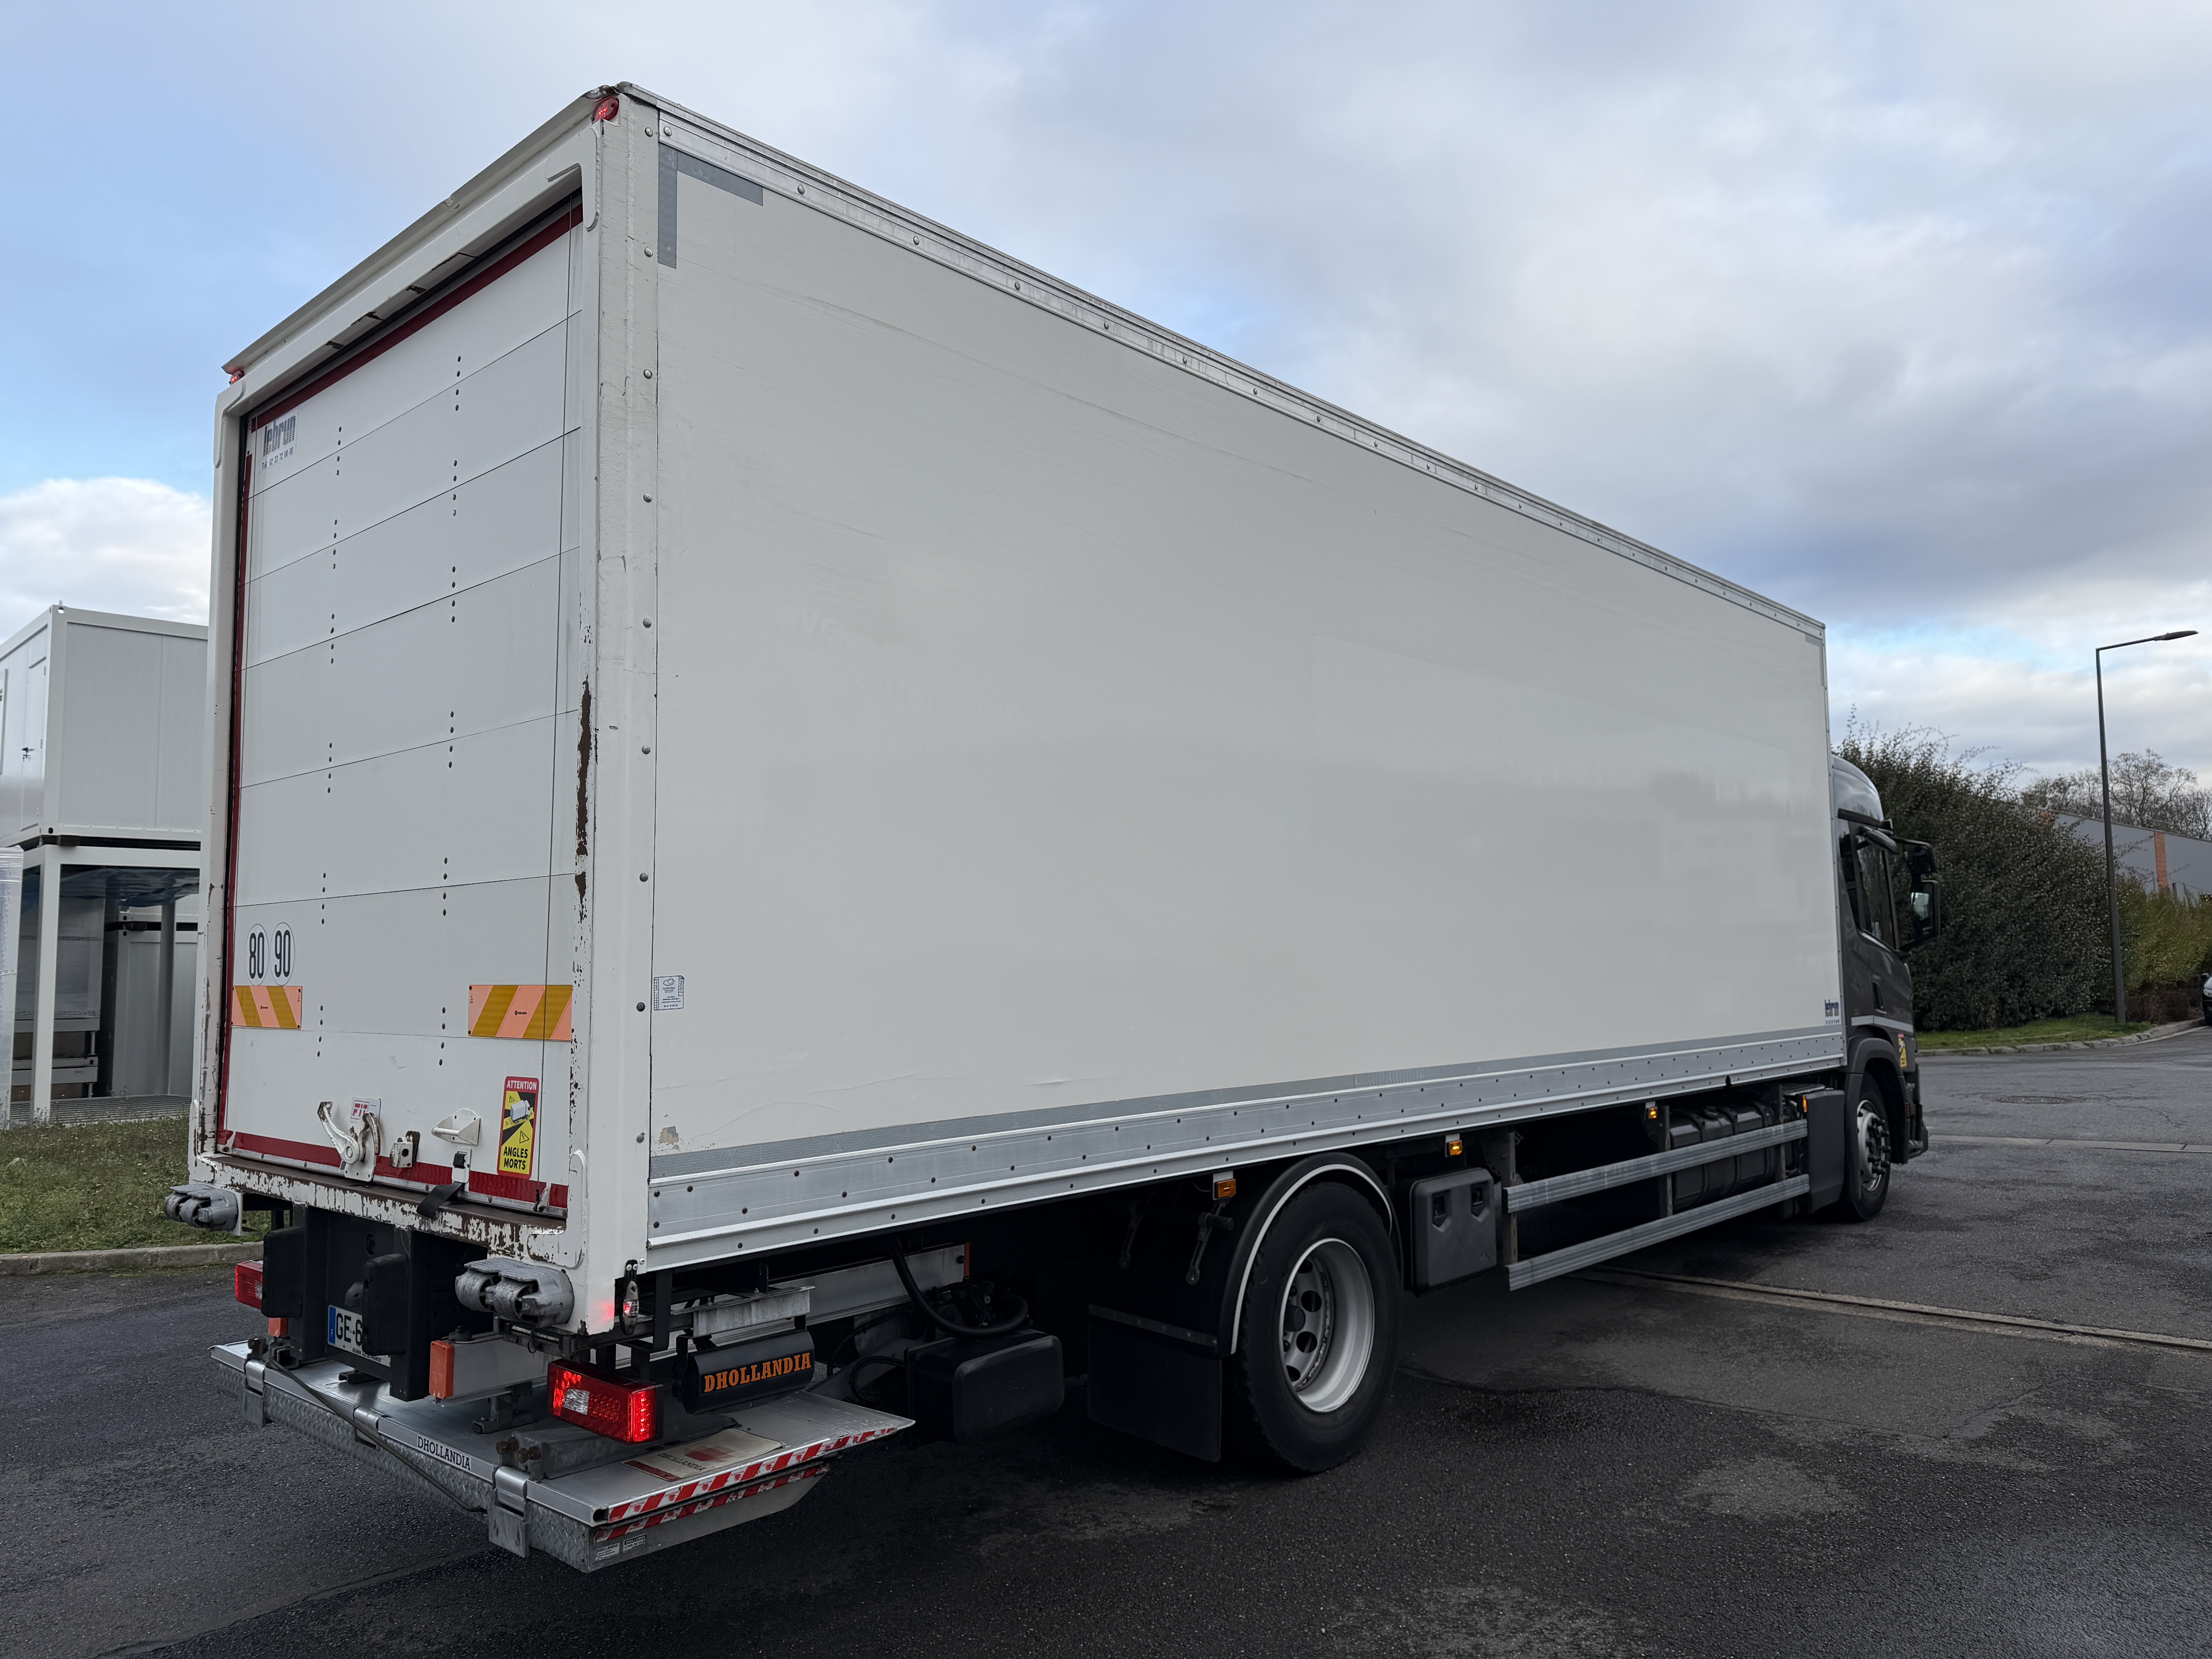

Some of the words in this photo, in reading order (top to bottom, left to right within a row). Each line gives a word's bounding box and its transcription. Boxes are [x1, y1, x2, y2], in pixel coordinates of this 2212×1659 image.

[279, 452, 283, 460] 72
[249, 932, 264, 979] 80
[275, 929, 290, 977] 90
[507, 1080, 537, 1090] ATTENTION
[503, 1146, 528, 1159] ANGLES
[503, 1158, 526, 1170] MORTS
[704, 1352, 812, 1393] DHOLLANDIA
[417, 1436, 471, 1470] DHOLLANDIA
[657, 1453, 706, 1471] DHOLLANDIA
